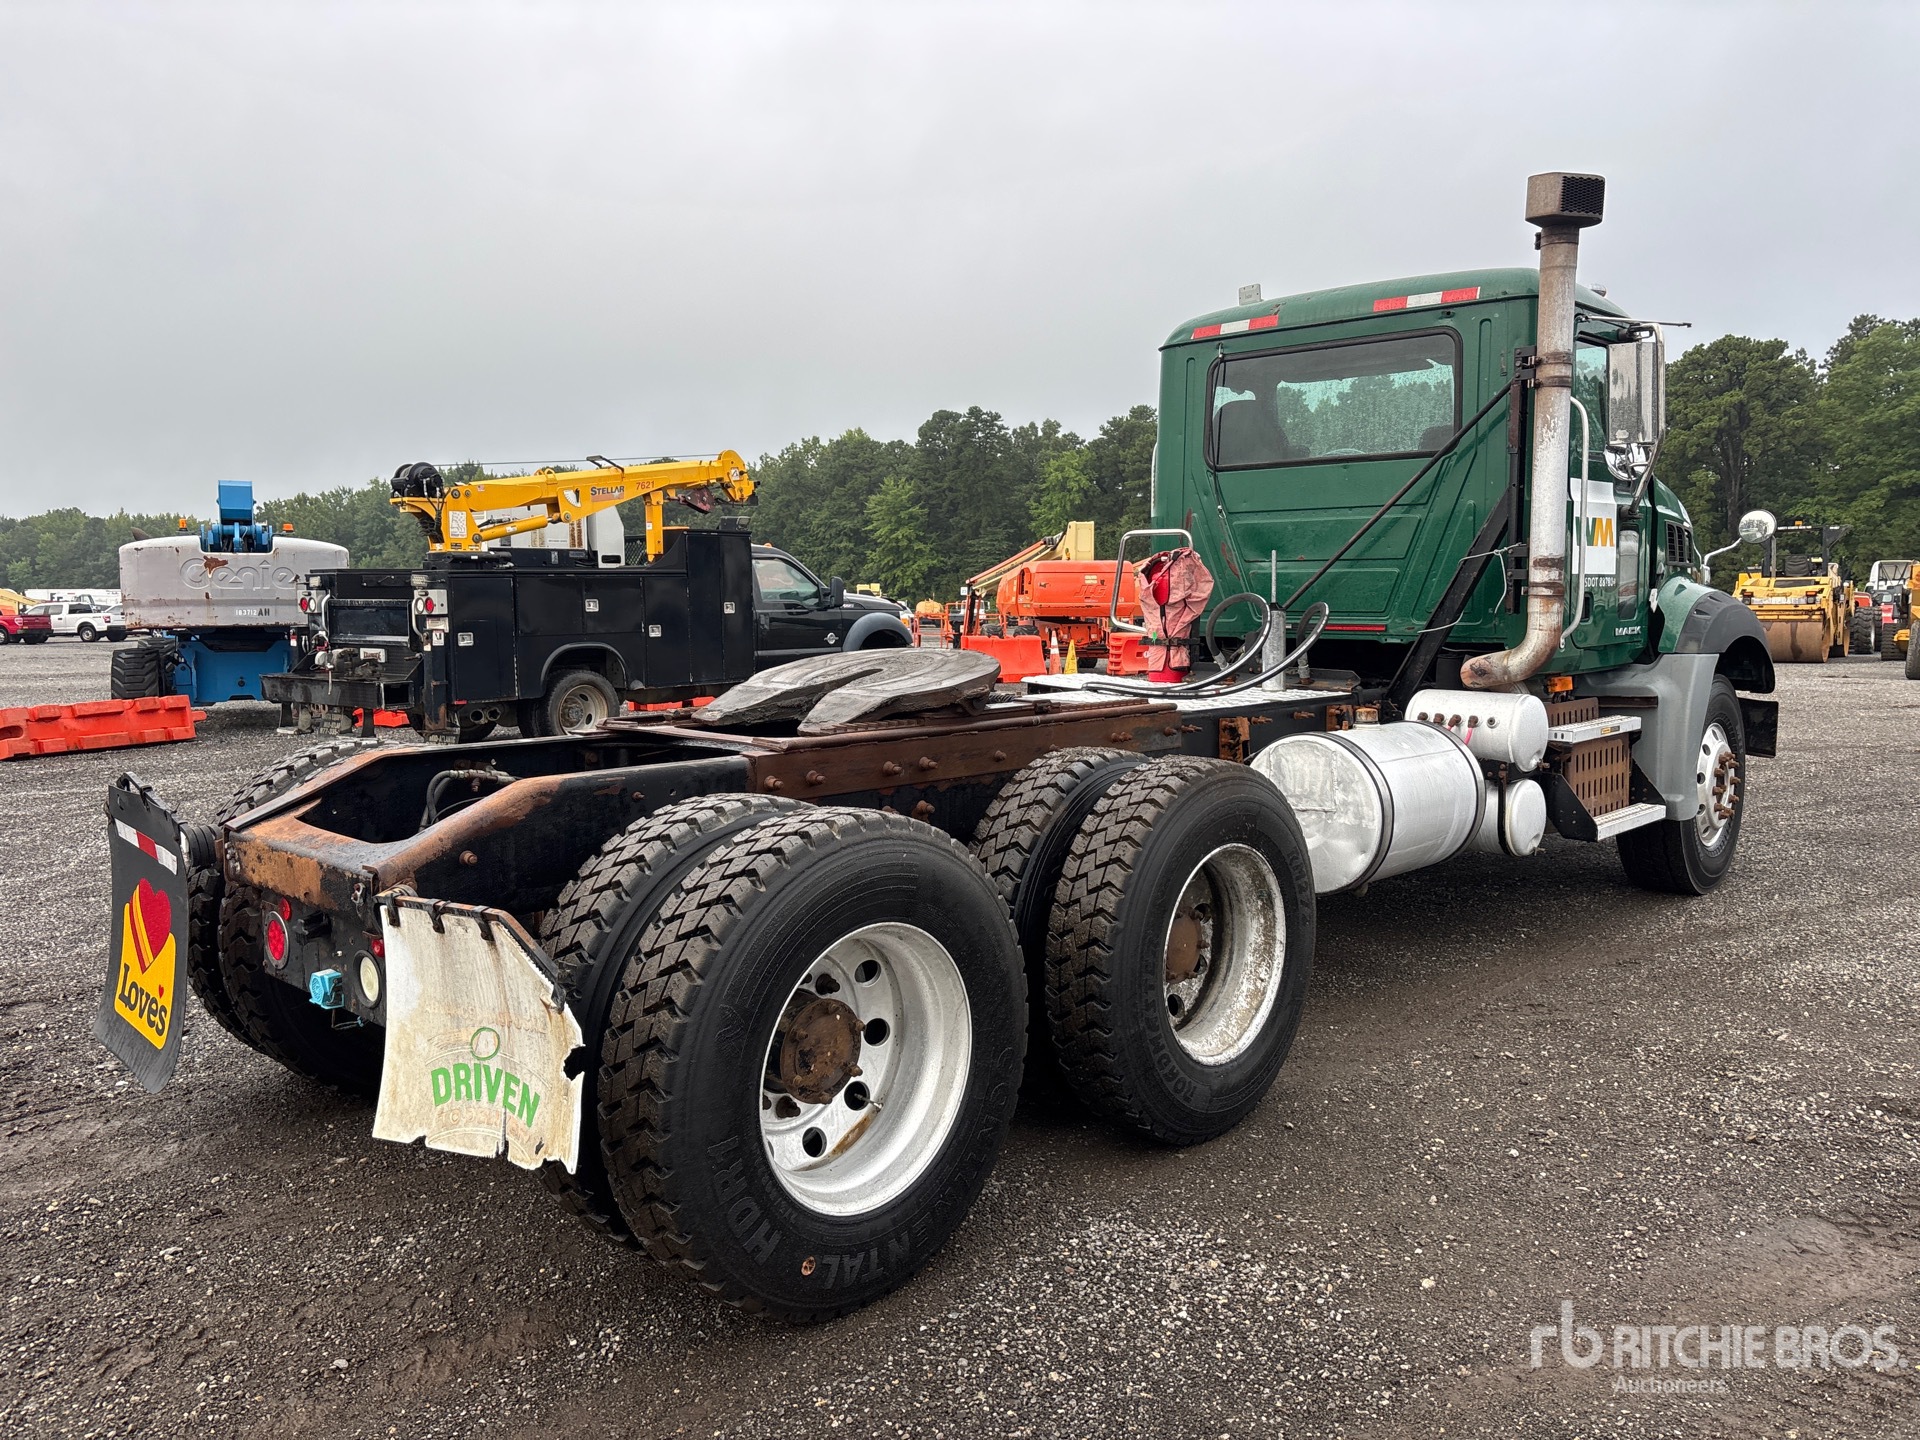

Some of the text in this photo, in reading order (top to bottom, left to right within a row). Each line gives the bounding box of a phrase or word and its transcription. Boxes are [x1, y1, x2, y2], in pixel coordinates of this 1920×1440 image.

[591, 486, 624, 495] STELLAR
[636, 481, 655, 490] 7621
[180, 558, 297, 591] Genie
[1584, 577, 1598, 588] SDOT
[1615, 626, 1642, 636] MACK
[430, 1062, 541, 1128] DRIVEN
